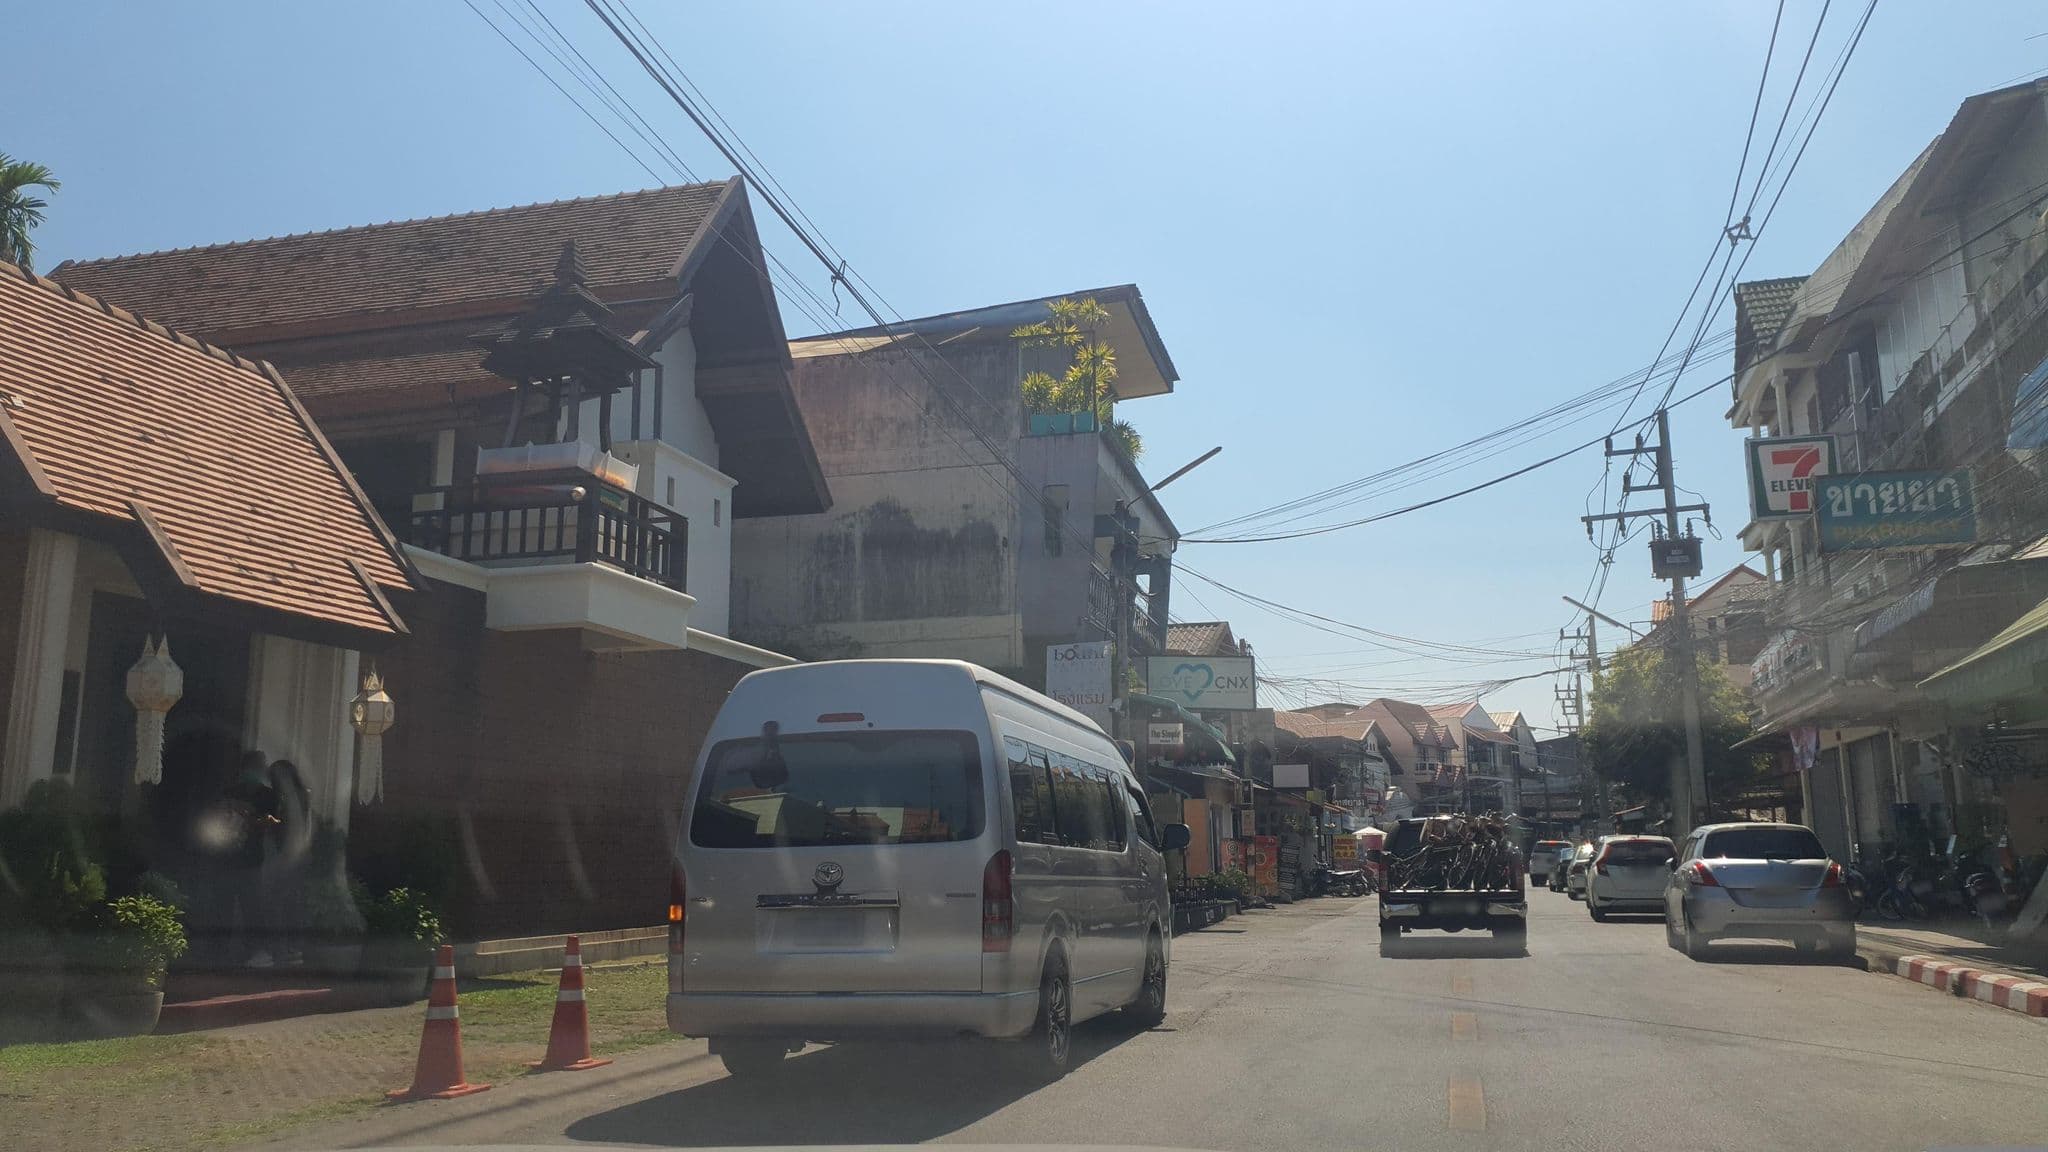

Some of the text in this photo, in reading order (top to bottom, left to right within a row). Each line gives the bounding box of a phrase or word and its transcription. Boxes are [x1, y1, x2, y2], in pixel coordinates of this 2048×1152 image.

[1771, 447, 1820, 511] 7
[1771, 479, 1814, 492] ELEVE
[1826, 477, 1961, 517] ขายยา
[1214, 676, 1249, 689] CNX
